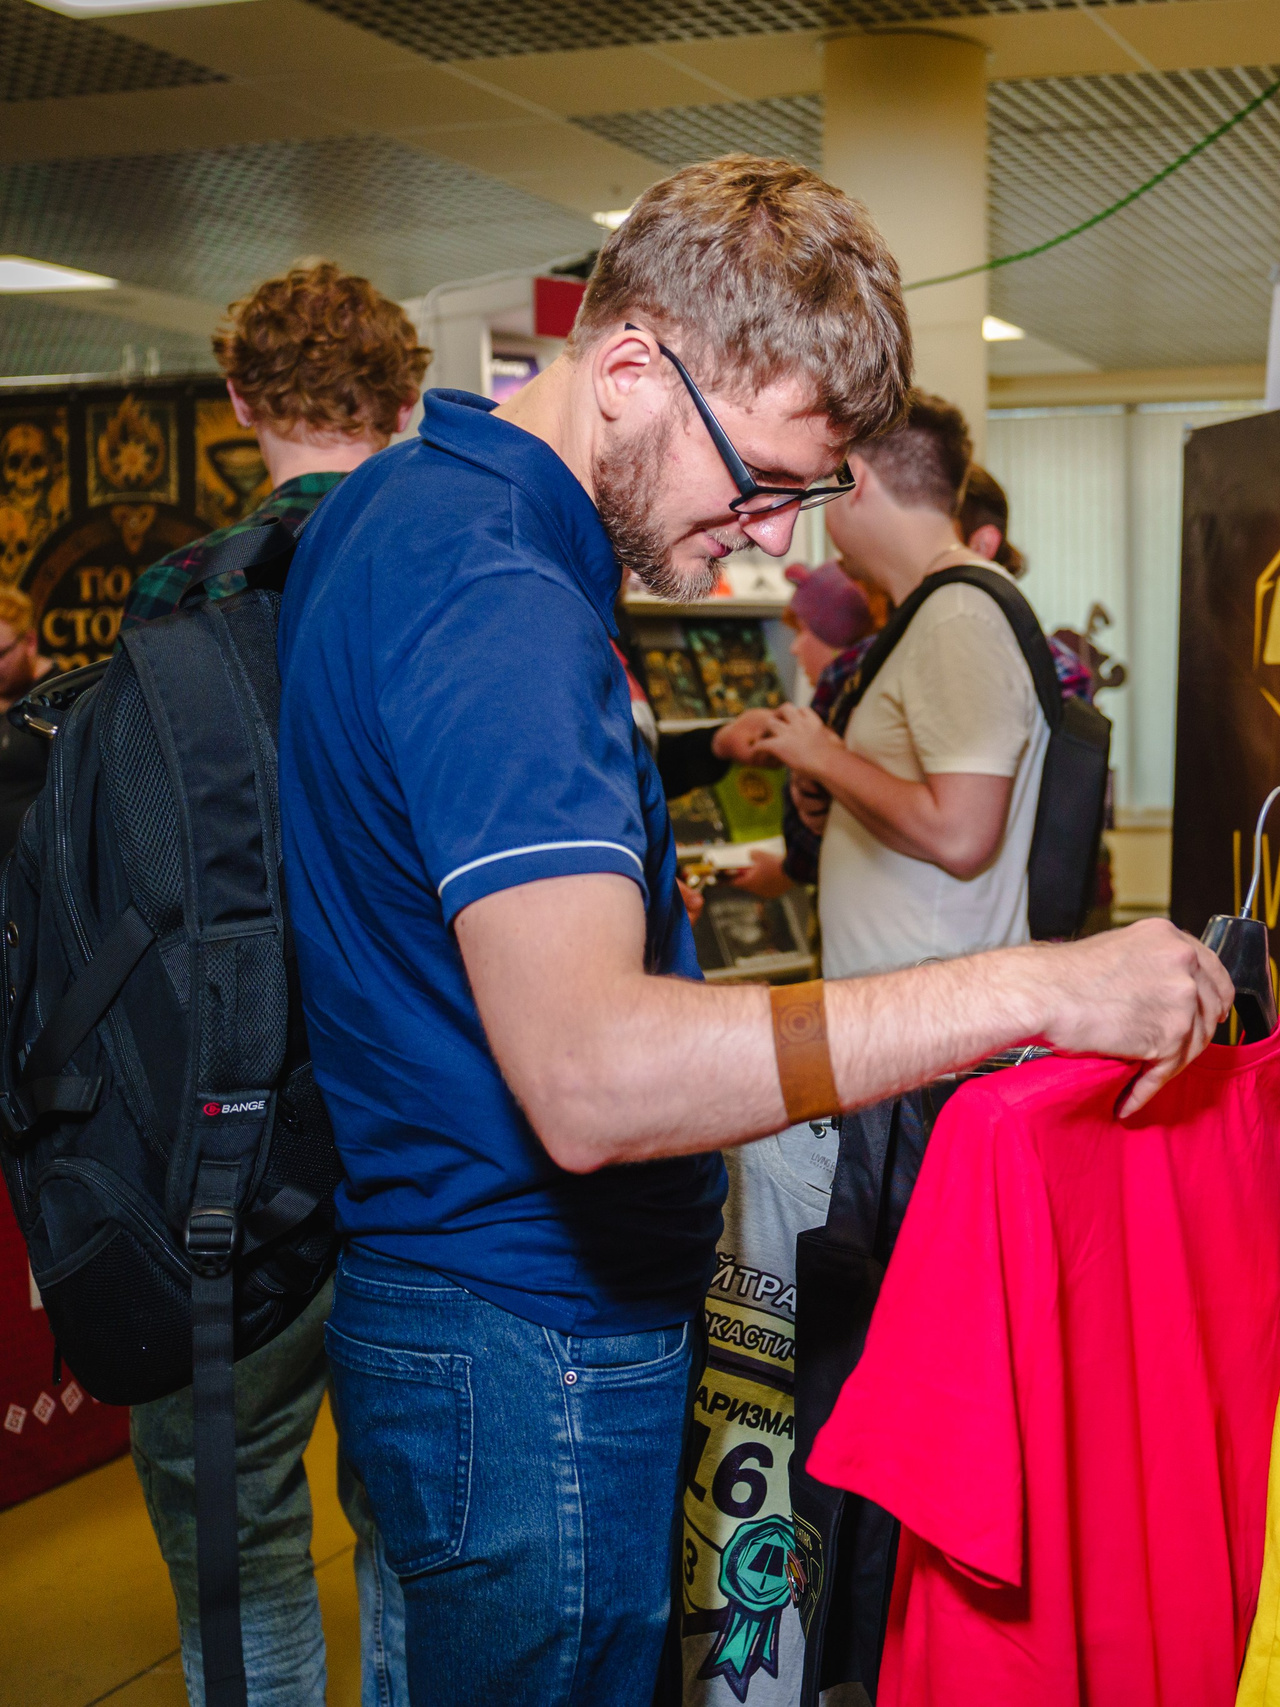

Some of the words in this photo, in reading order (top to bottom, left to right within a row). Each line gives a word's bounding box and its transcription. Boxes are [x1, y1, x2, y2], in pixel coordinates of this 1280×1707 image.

[78, 565, 141, 602] ПО
[43, 606, 124, 647] СТО
[221, 1100, 266, 1114] BANGE
[705, 1313, 796, 1358] КАСТИ
[694, 1385, 794, 1440] АРИЗМА
